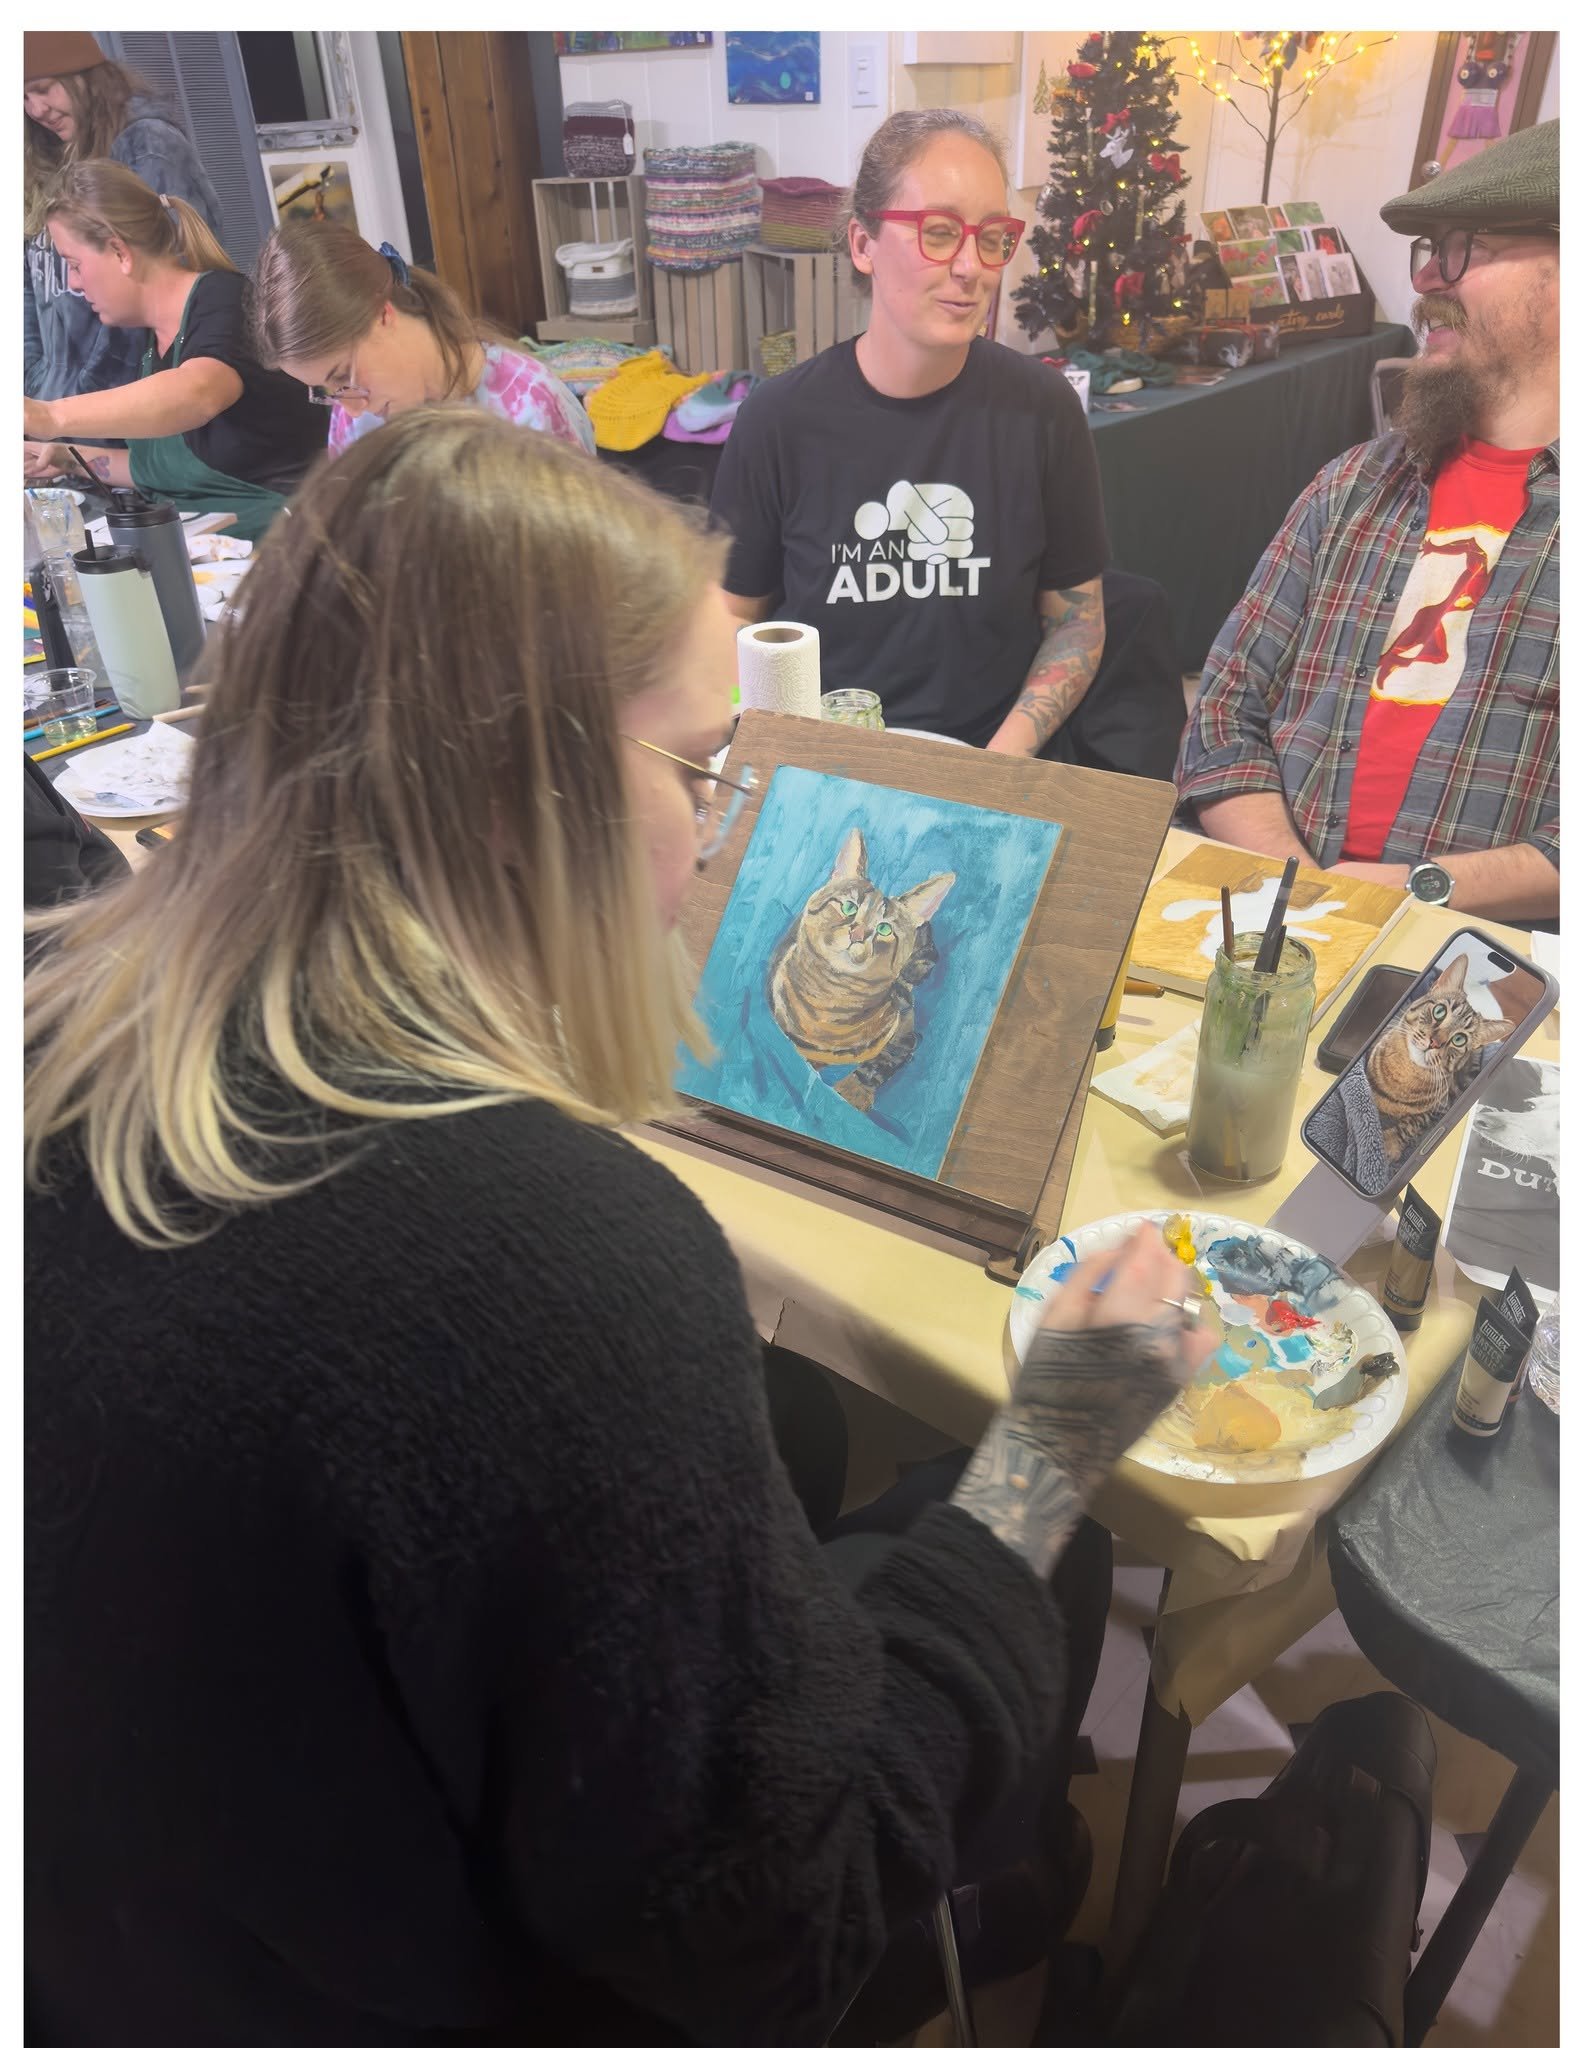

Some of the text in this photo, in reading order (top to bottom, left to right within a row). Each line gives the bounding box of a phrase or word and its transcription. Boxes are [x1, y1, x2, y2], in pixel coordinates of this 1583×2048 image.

[831, 539, 905, 564] I'M AN
[826, 557, 991, 604] ADULT
[1480, 1319, 1511, 1355] Liquitex
